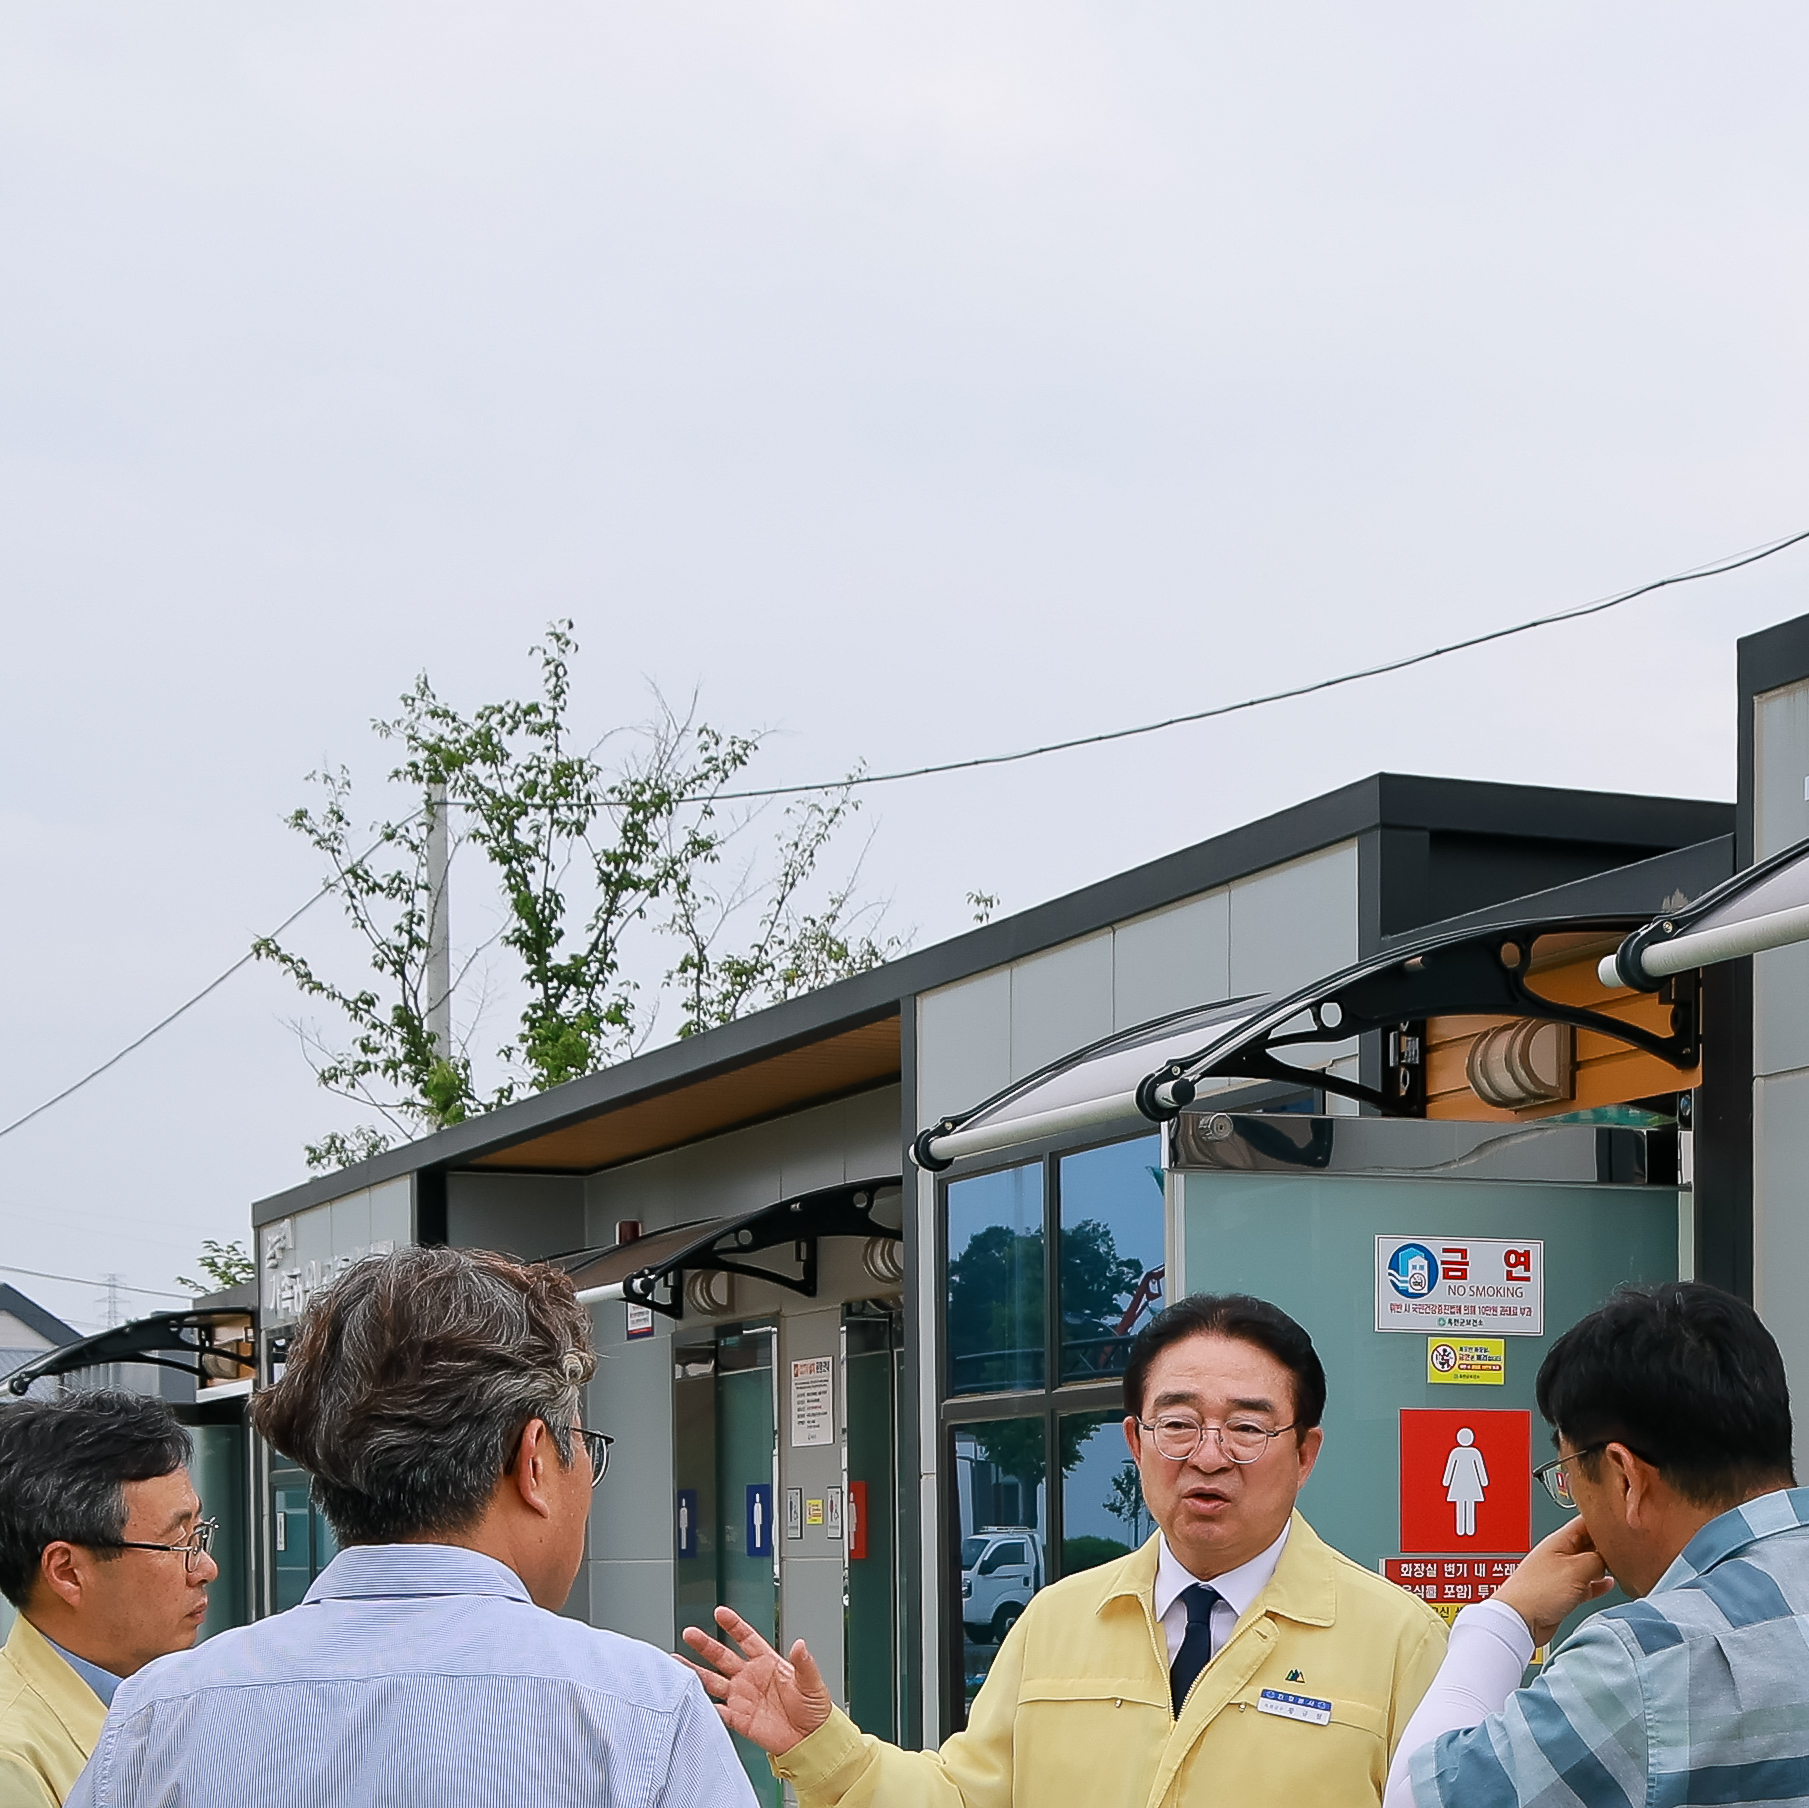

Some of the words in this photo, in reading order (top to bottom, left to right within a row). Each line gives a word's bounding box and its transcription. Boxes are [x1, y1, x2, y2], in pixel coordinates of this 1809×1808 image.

[1440, 1248, 1469, 1280] 금
[1503, 1249, 1531, 1282] 연
[1447, 1284, 1466, 1296] NO
[1469, 1286, 1524, 1298] SMOKING
[1390, 1303, 1402, 1313] 위반
[1404, 1303, 1410, 1313] 시
[1400, 1563, 1437, 1578] 화장실
[1444, 1563, 1468, 1578] 변기
[1474, 1563, 1486, 1578] 내
[1492, 1563, 1519, 1577] 쓰레
[1443, 1584, 1472, 1600] 포함]
